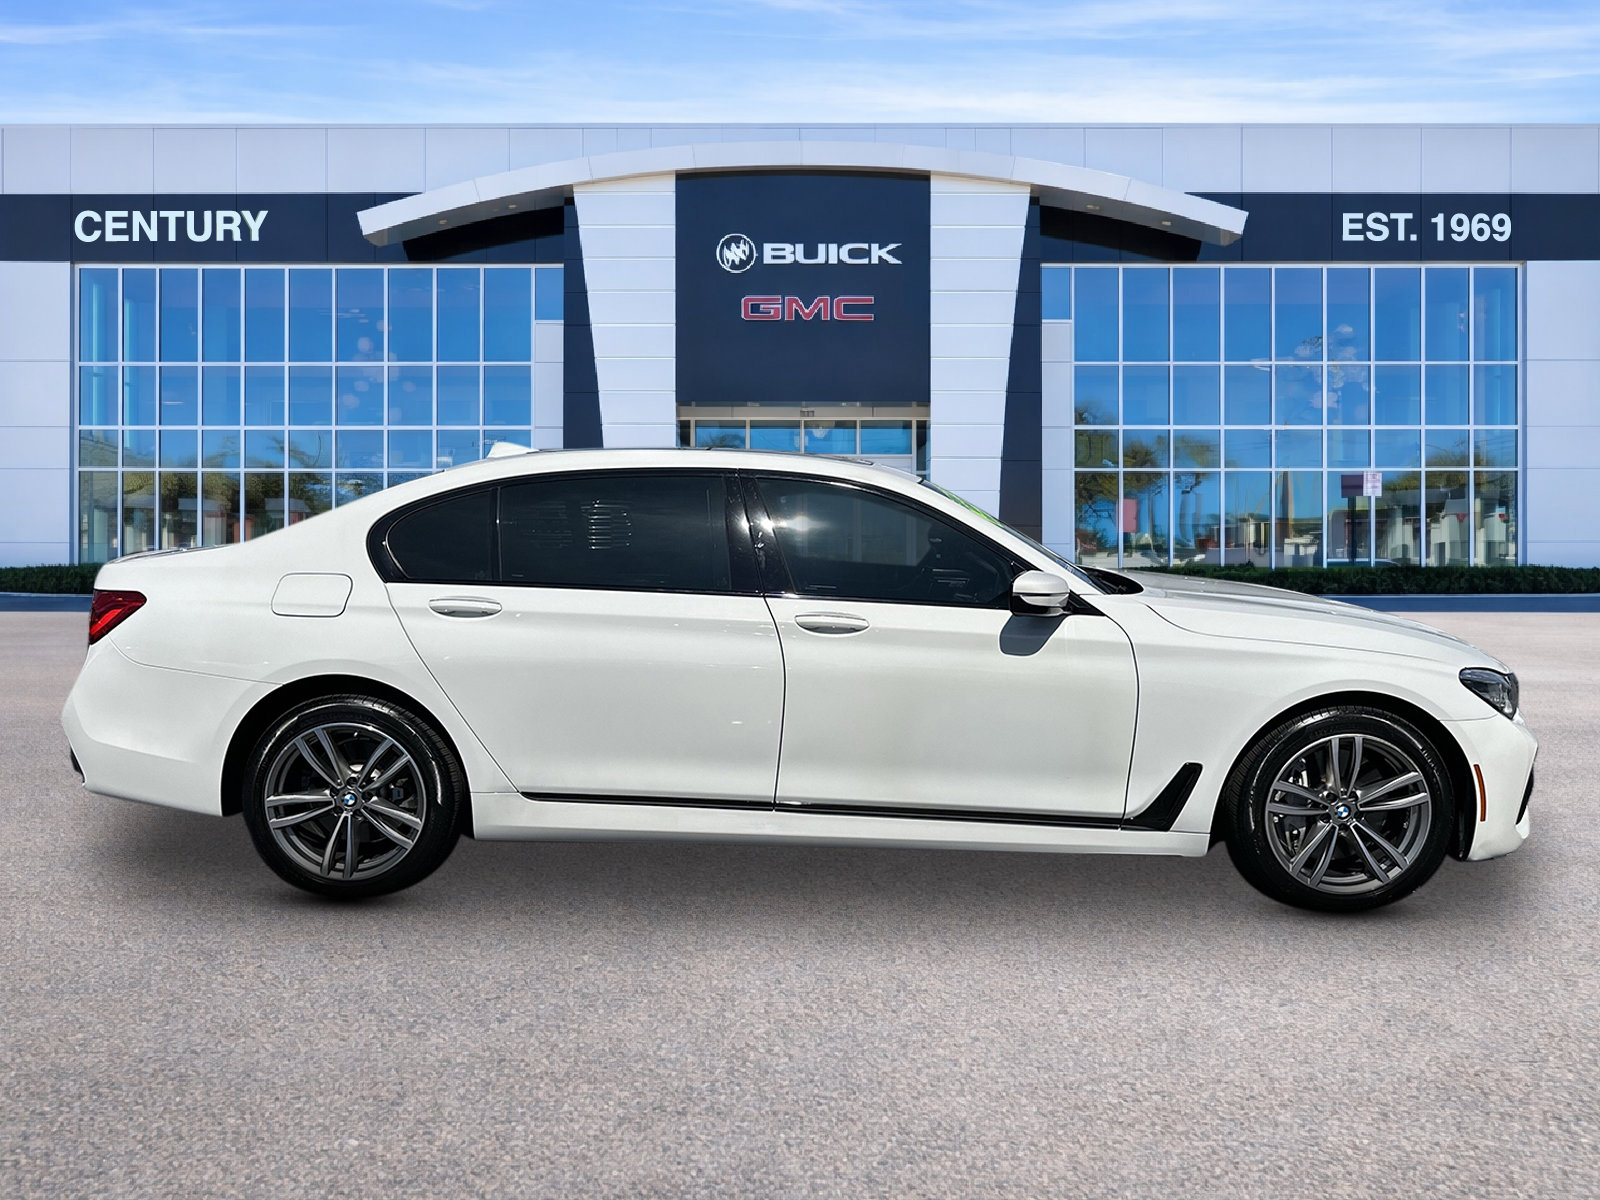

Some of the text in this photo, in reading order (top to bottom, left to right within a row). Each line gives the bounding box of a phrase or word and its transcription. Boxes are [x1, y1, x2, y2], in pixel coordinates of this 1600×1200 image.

[75, 210, 268, 242] CENTURY
[1342, 212, 1511, 242] EST. 1969
[763, 243, 902, 264] BUICK
[741, 295, 874, 320] GMC
